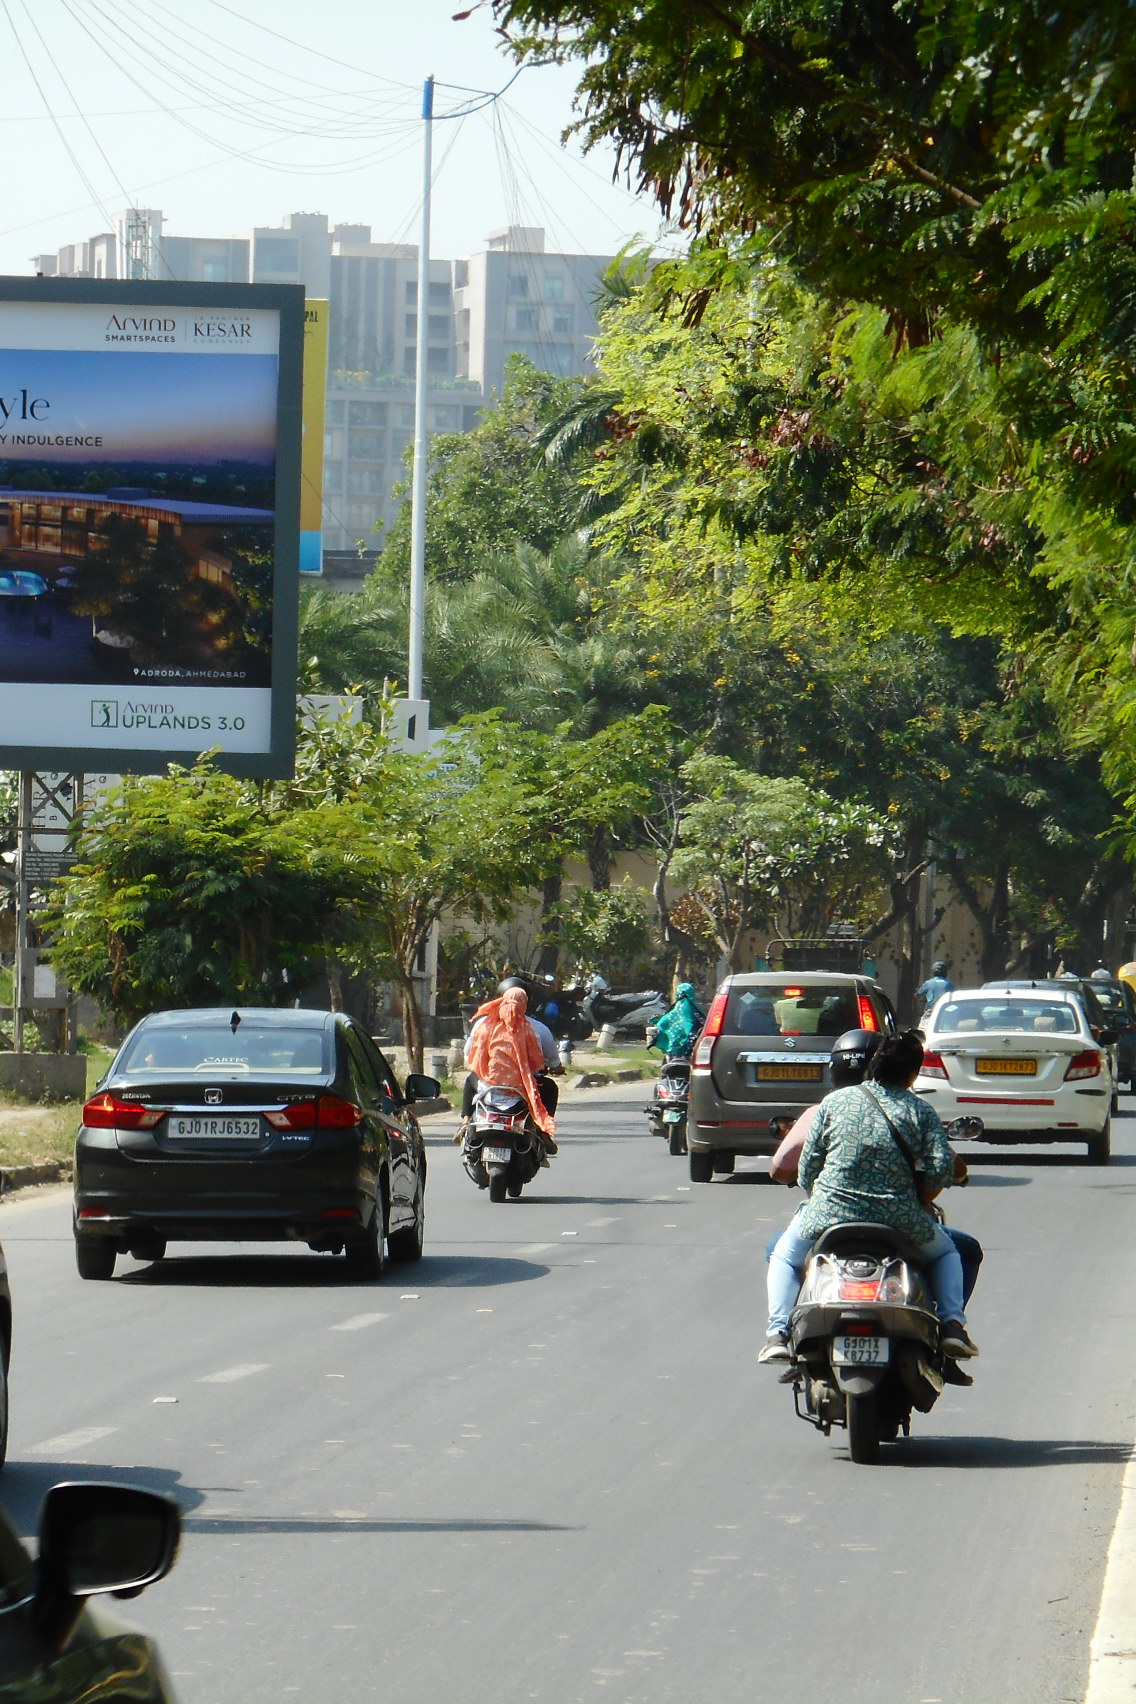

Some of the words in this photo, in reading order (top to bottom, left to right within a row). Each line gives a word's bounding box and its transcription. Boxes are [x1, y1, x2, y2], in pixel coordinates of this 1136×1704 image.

[194, 322, 252, 338] KESAR
[105, 334, 176, 343] SMARTSPACES
[12, 435, 103, 447] INDULGENCE
[140, 669, 184, 678] ADRODA,
[185, 671, 247, 679] AHMEDABAD
[122, 714, 211, 730] UPLANDS
[217, 716, 245, 731] 3.0
